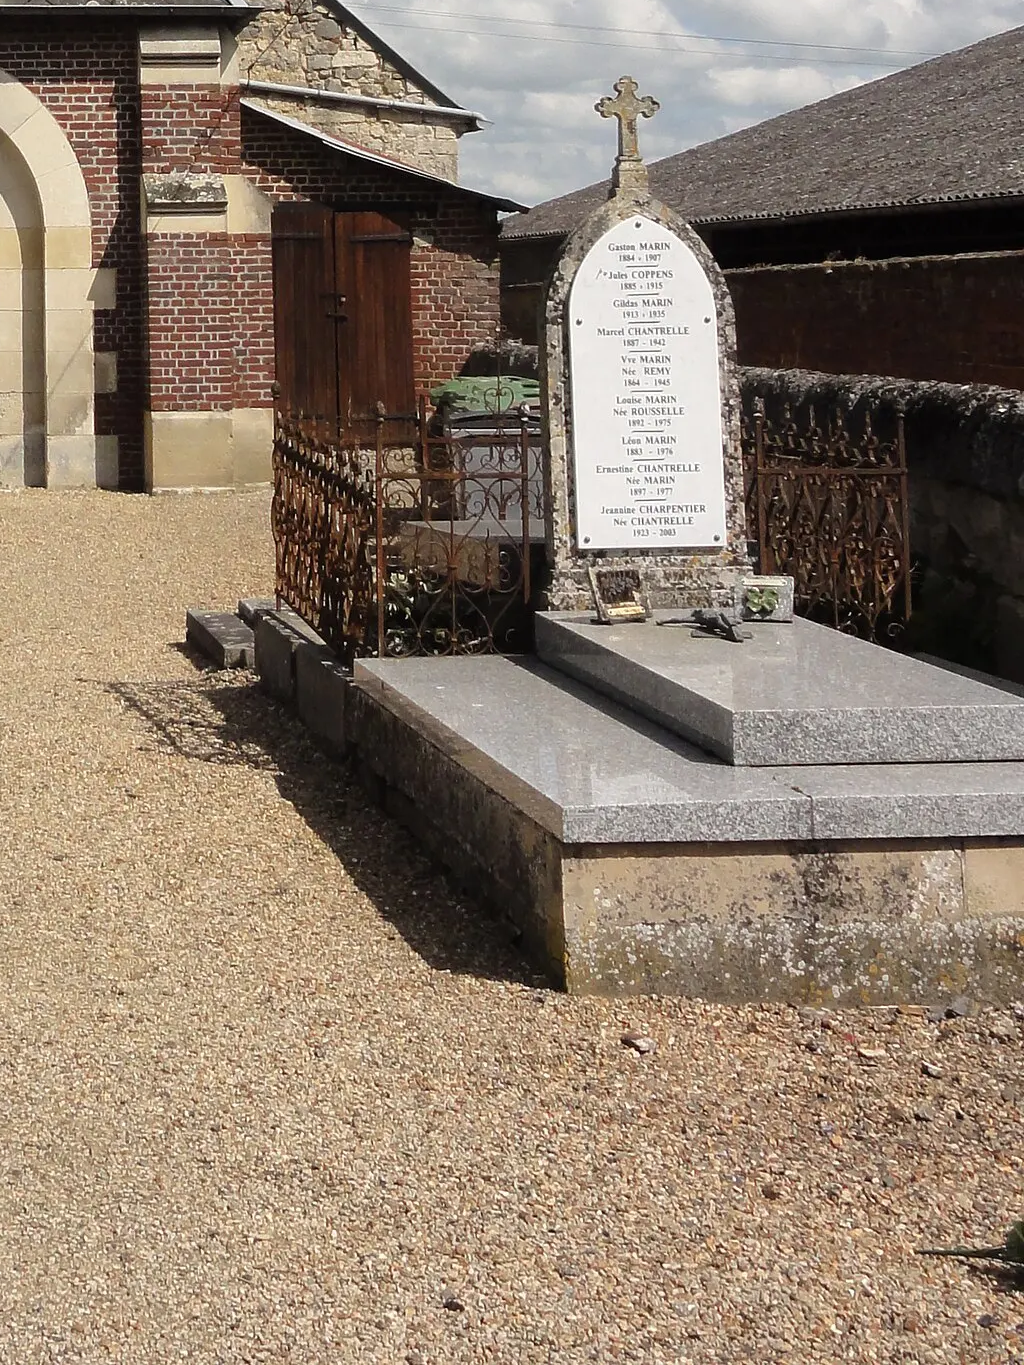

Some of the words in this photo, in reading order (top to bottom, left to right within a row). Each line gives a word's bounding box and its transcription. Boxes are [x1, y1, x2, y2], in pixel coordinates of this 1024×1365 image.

[608, 242, 636, 252] Gaston
[640, 242, 670, 250] MARIN
[646, 254, 662, 262] 1907
[608, 272, 628, 280] Jules
[632, 270, 674, 278] COPPENS
[646, 282, 662, 290] 1915
[612, 300, 638, 308] Gildas
[642, 298, 672, 308] MARIN
[622, 310, 638, 318] 1913
[650, 310, 666, 318] 1935
[598, 328, 624, 336] Marcel
[628, 326, 690, 336] CHANTRELLE
[624, 338, 640, 346] 1887
[650, 338, 666, 346] 1942
[640, 356, 670, 364] MARIN
[644, 366, 670, 376] REMY
[654, 378, 670, 386] 1945
[616, 396, 642, 404] Louise
[646, 396, 676, 404] MARIN
[632, 406, 684, 416] ROUSSELLE
[654, 418, 672, 426] 1975
[646, 436, 676, 444] MARIN
[658, 448, 674, 456] 1976
[596, 466, 634, 474] Ernestine
[638, 464, 700, 472] CHANTRELLE
[644, 476, 676, 484] MARIN
[630, 488, 646, 496] 1897
[656, 488, 672, 496] 1977
[600, 506, 636, 514] Jeannine
[640, 504, 706, 514] CHARPENTIER
[630, 516, 694, 526] CHANTRELLE
